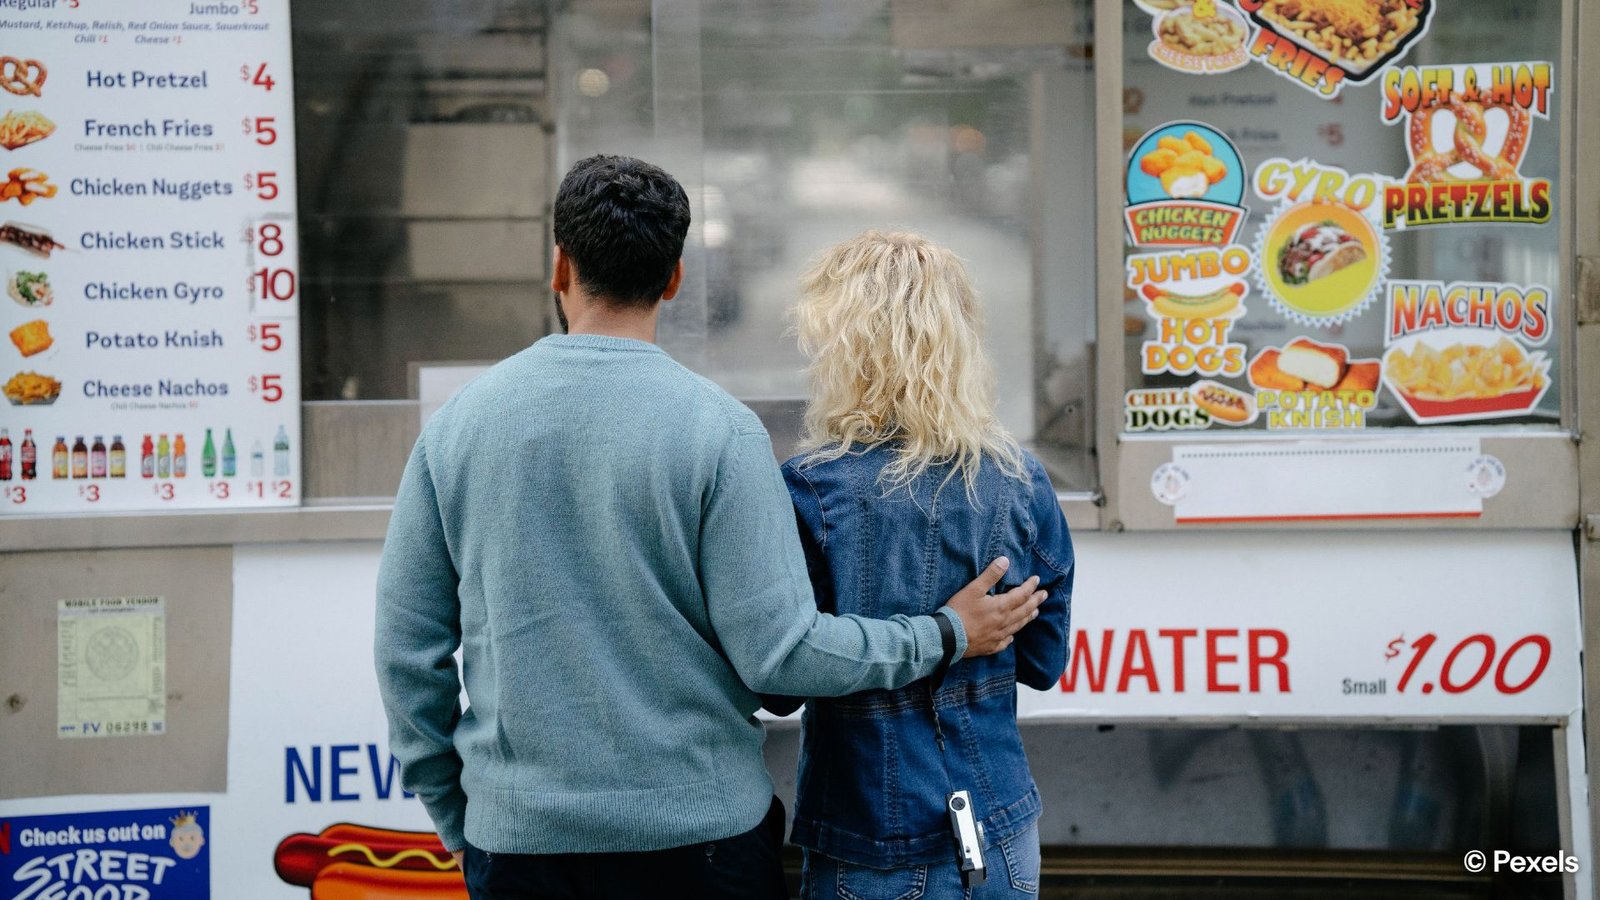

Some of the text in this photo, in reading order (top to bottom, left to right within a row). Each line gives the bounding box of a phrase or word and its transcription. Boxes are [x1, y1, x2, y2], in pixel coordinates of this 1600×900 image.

[189, 2, 239, 15] Jumbo
[0, 20, 269, 31] Mustard, Ketchup, Relish, Red Onion Sauce, Sauerkraut
[74, 34, 96, 43] Chili
[134, 35, 169, 43] Cheese
[1252, 27, 1346, 94] FRIES
[87, 62, 275, 91] Hot Pretzel $4
[1385, 64, 1550, 120] SOFT & HOT
[84, 117, 277, 146] French Fries $5
[70, 172, 278, 200] Chicken Nuggets $5
[1258, 162, 1376, 211] GYRO
[1136, 207, 1232, 227] CHICKEN
[1384, 180, 1552, 228] PRETZELS
[80, 232, 164, 249] Chicken
[170, 230, 225, 248] Stick
[1140, 226, 1225, 243] NUGGETS
[1131, 249, 1250, 284] JUMBO
[84, 282, 168, 300] Chicken
[174, 283, 223, 305] Gyro
[1392, 286, 1548, 340] NACHOS
[86, 323, 282, 352] Potato Knish $5
[1161, 319, 1230, 344] HOT
[1146, 345, 1244, 373] DOGS
[83, 375, 283, 403] Cheese Nachos $5
[1257, 390, 1376, 410] POTATO
[1130, 409, 1209, 428] DOGS
[1269, 409, 1364, 429] KNISH
[1060, 629, 1293, 693] WATER
[1342, 633, 1552, 695] Small $1.00
[82, 723, 101, 734] FV
[20, 826, 81, 847] Check
[83, 829, 106, 844] us
[108, 823, 140, 841] out
[141, 824, 166, 840] on
[13, 849, 176, 900] STREET
